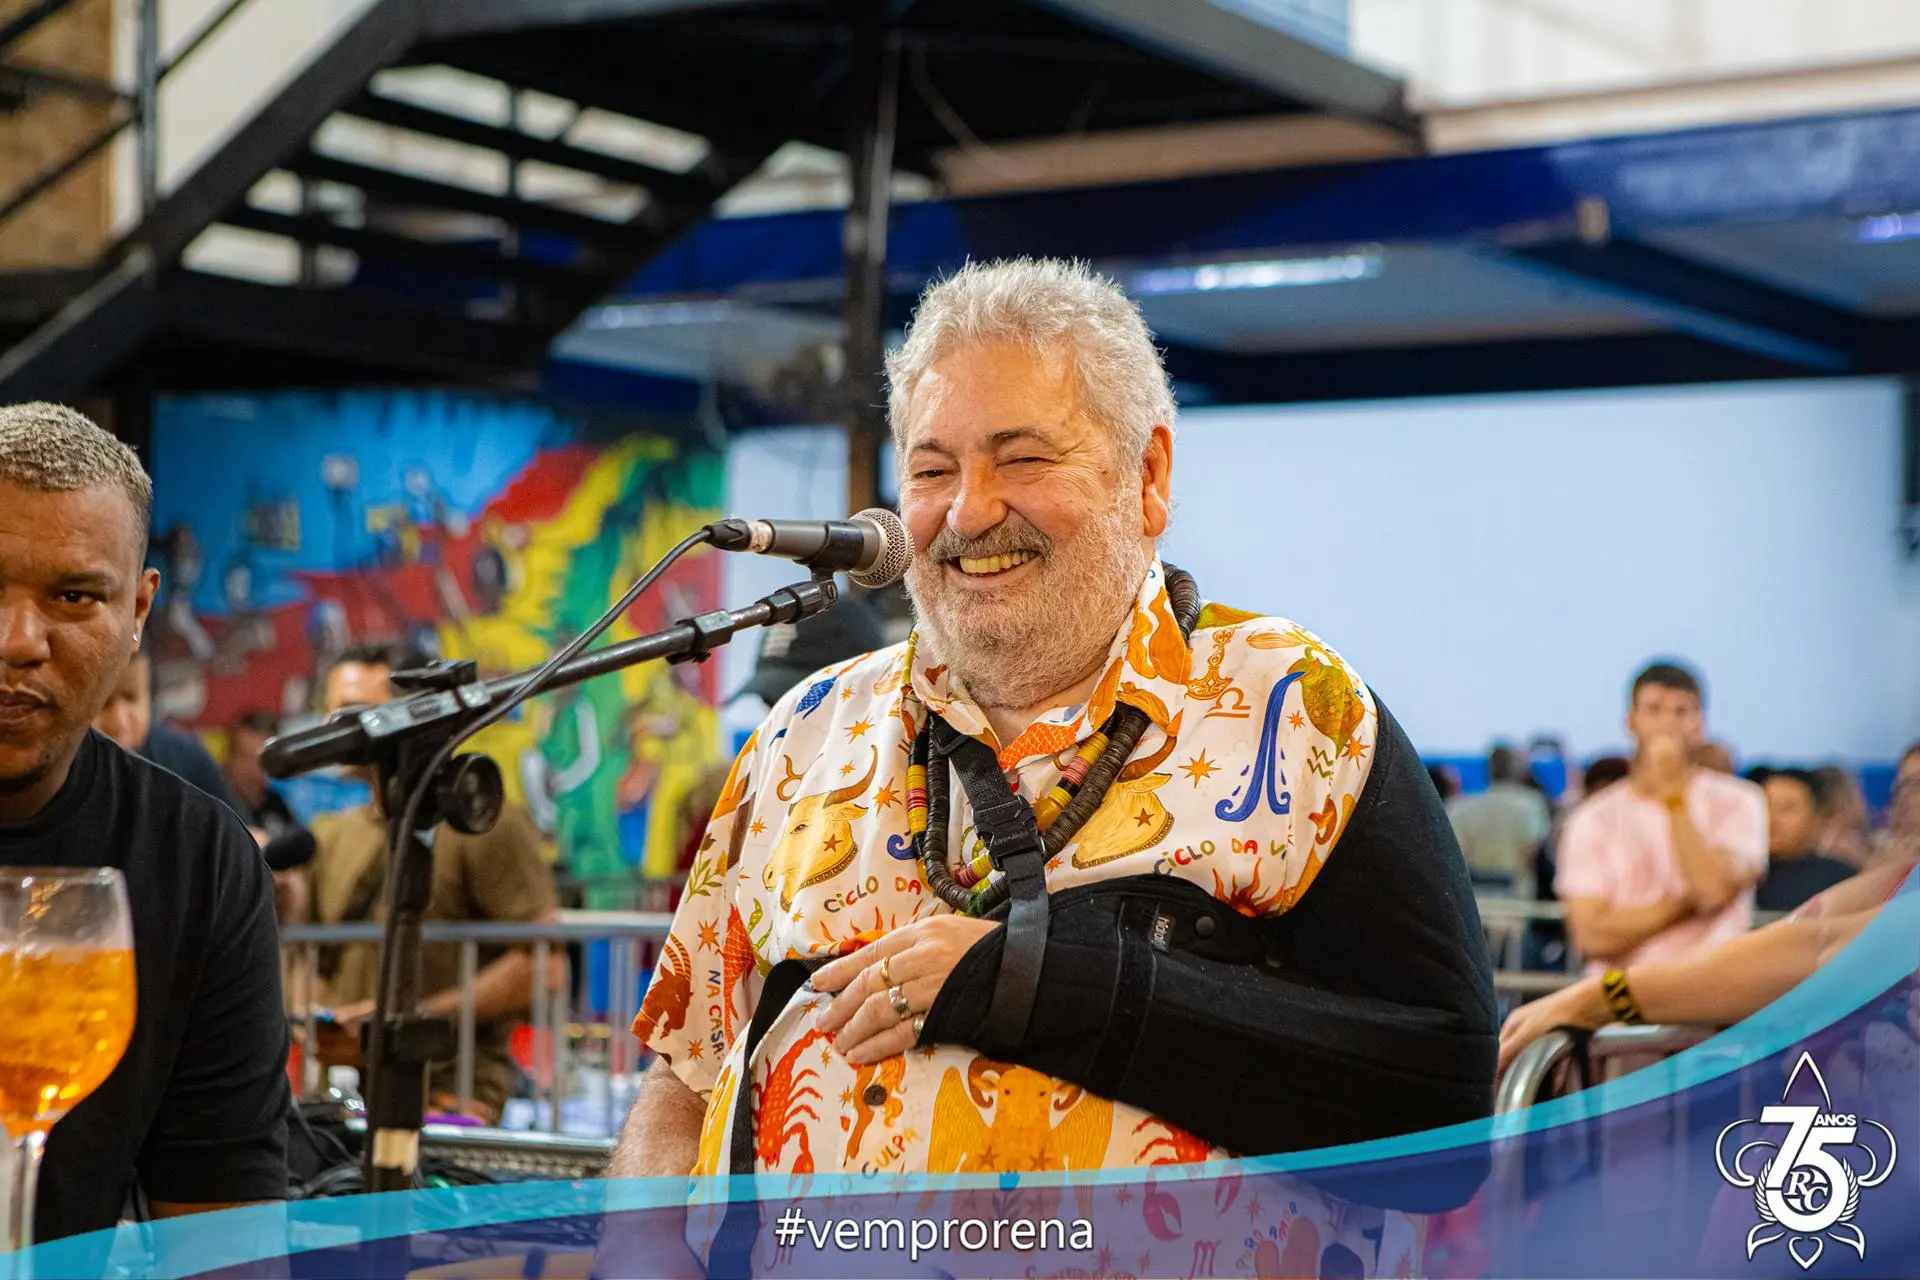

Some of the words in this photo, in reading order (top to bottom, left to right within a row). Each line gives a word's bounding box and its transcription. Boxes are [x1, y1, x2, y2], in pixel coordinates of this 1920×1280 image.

[1231, 838, 1258, 855] DA
[895, 877, 922, 895] DA
[706, 969, 721, 998] NA
